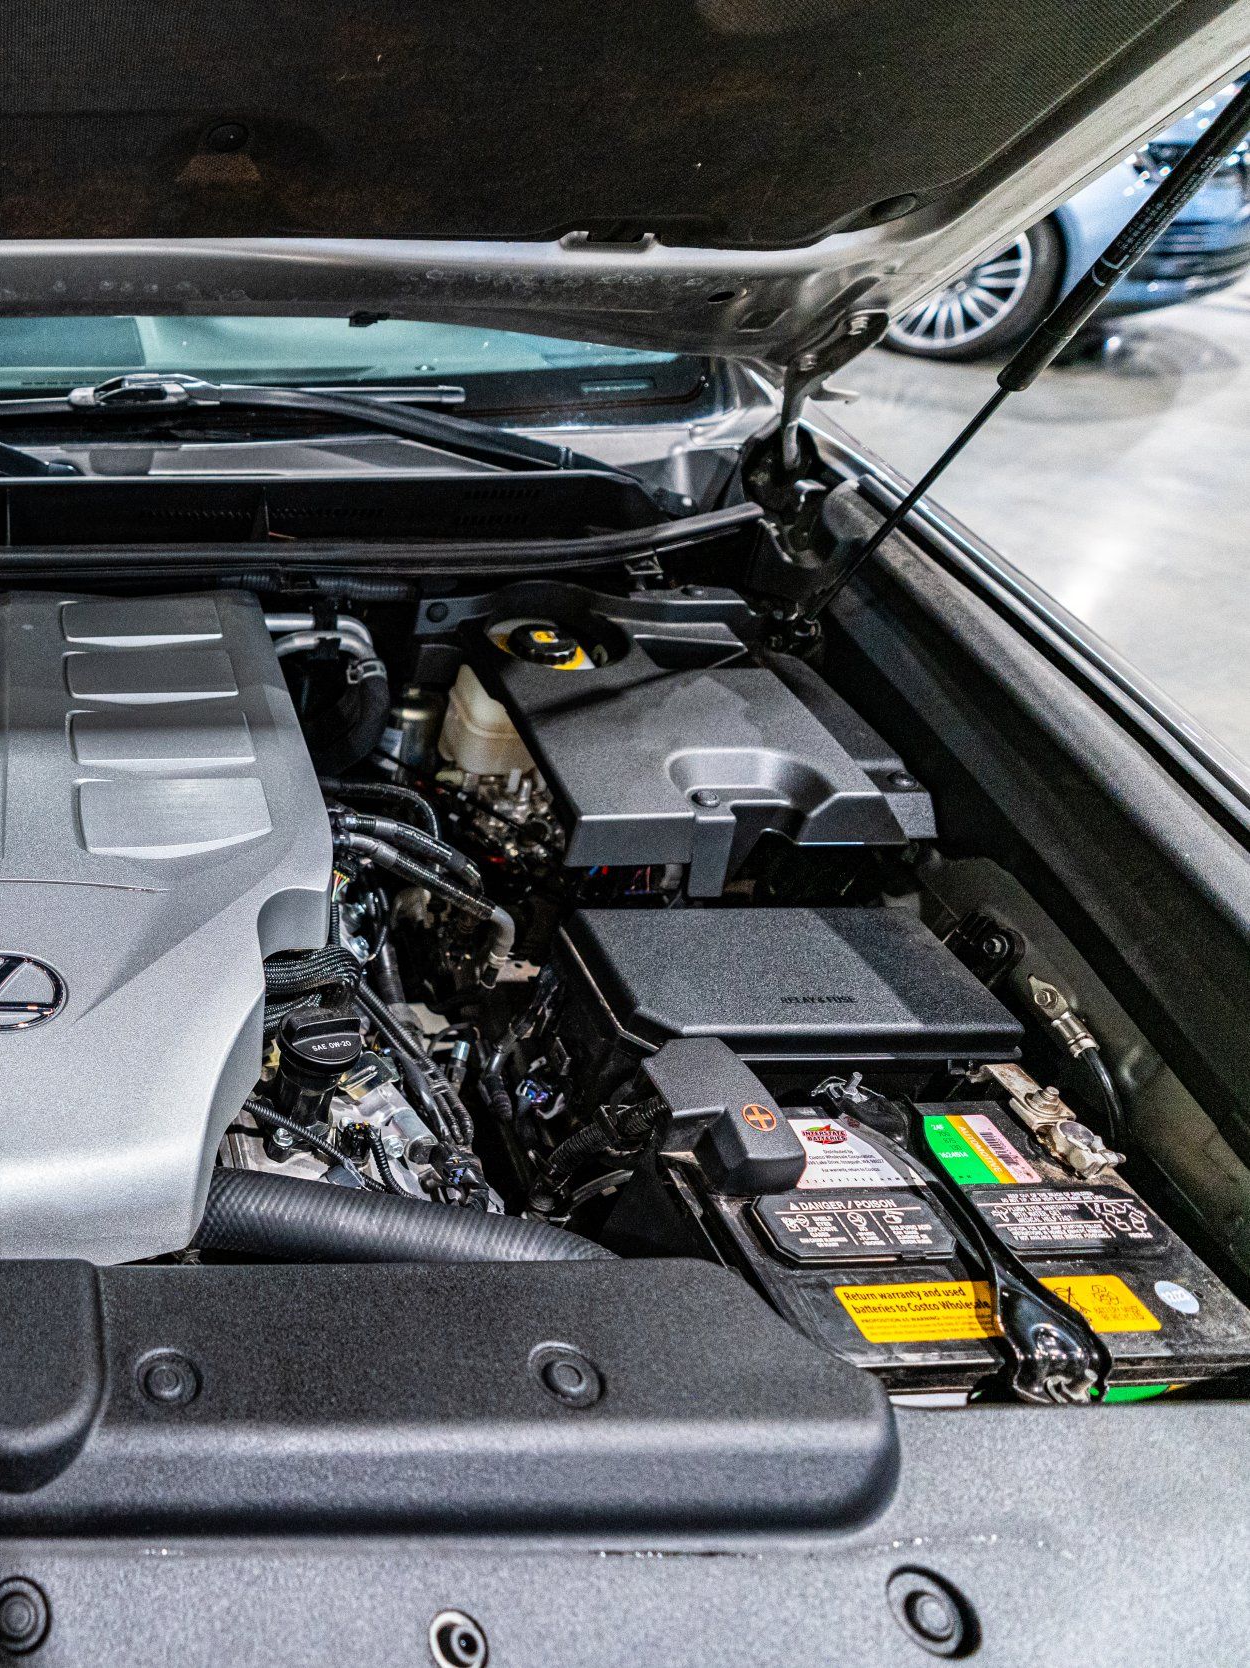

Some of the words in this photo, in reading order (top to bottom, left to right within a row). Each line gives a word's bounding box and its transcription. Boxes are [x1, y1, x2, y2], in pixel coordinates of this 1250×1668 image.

[958, 1126, 1002, 1172] AUTOMOTIVE
[800, 1201, 845, 1210] DANGER
[847, 1201, 852, 1209] /
[855, 1199, 897, 1209] POISON
[844, 1292, 876, 1300] Return
[879, 1290, 922, 1300] warranty
[923, 1288, 941, 1297] and
[942, 1287, 966, 1296] used
[852, 1304, 895, 1314] batteries
[896, 1304, 907, 1312] to
[908, 1302, 939, 1312] Costco
[939, 1299, 991, 1310] Wholesale
